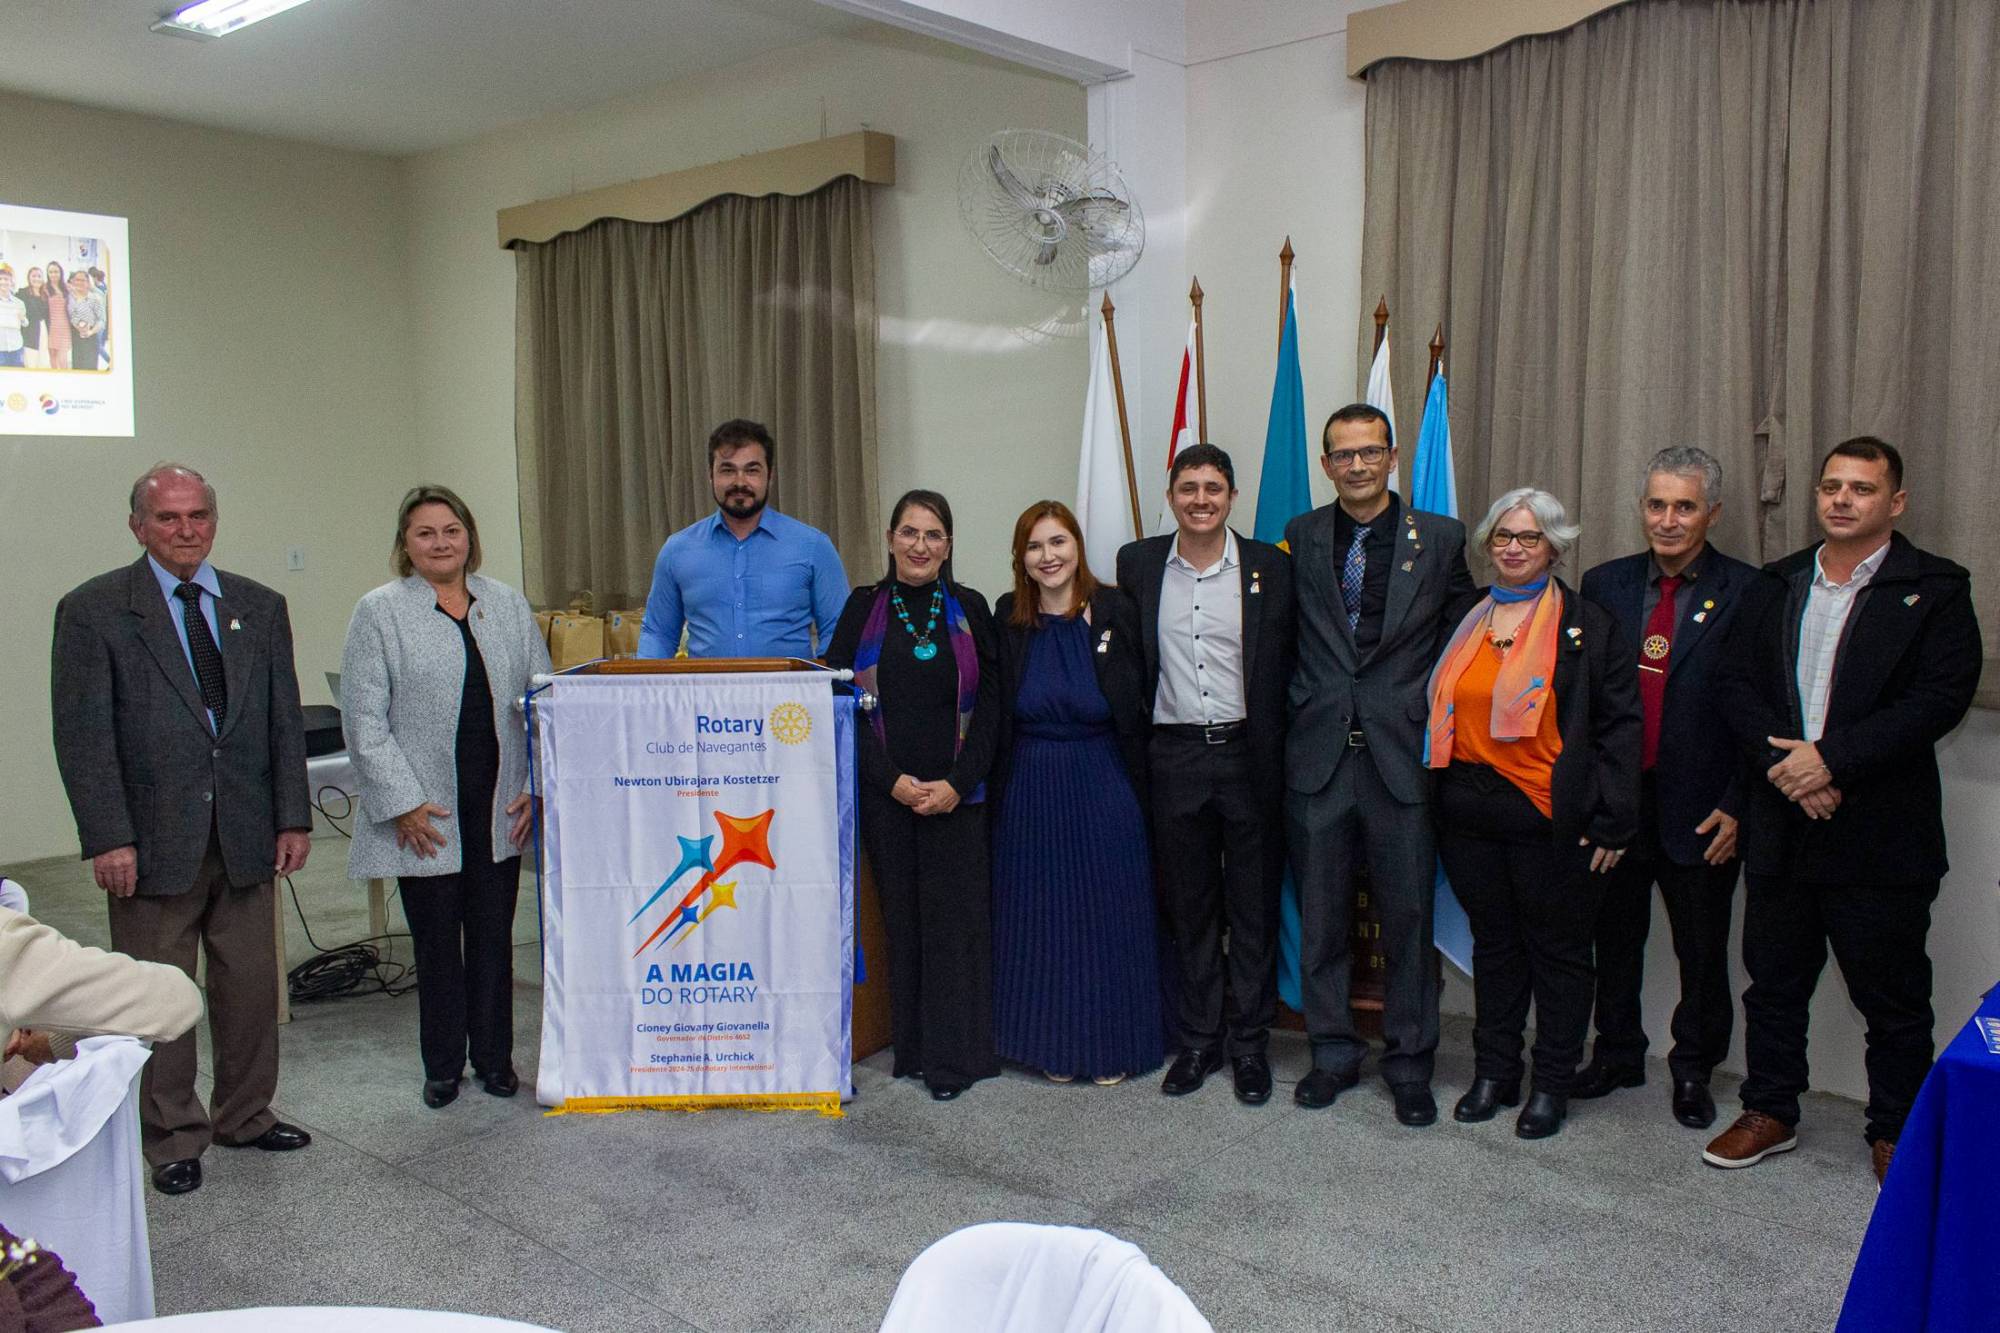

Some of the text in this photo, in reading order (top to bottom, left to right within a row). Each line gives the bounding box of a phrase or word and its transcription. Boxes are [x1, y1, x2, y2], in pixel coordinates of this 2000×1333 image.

[697, 715, 764, 736] Rotary
[646, 741, 768, 756] Club de Navegantes
[614, 774, 781, 788] Newton Ubirajara Kostetzer
[677, 789, 720, 797] Presidente
[646, 962, 755, 982] A MAGIA
[642, 985, 758, 1005] DO ROTARY
[673, 1022, 714, 1033] Giovany
[716, 1021, 770, 1031] Giovanella
[650, 1051, 755, 1064] Stephanie A. Urchick
